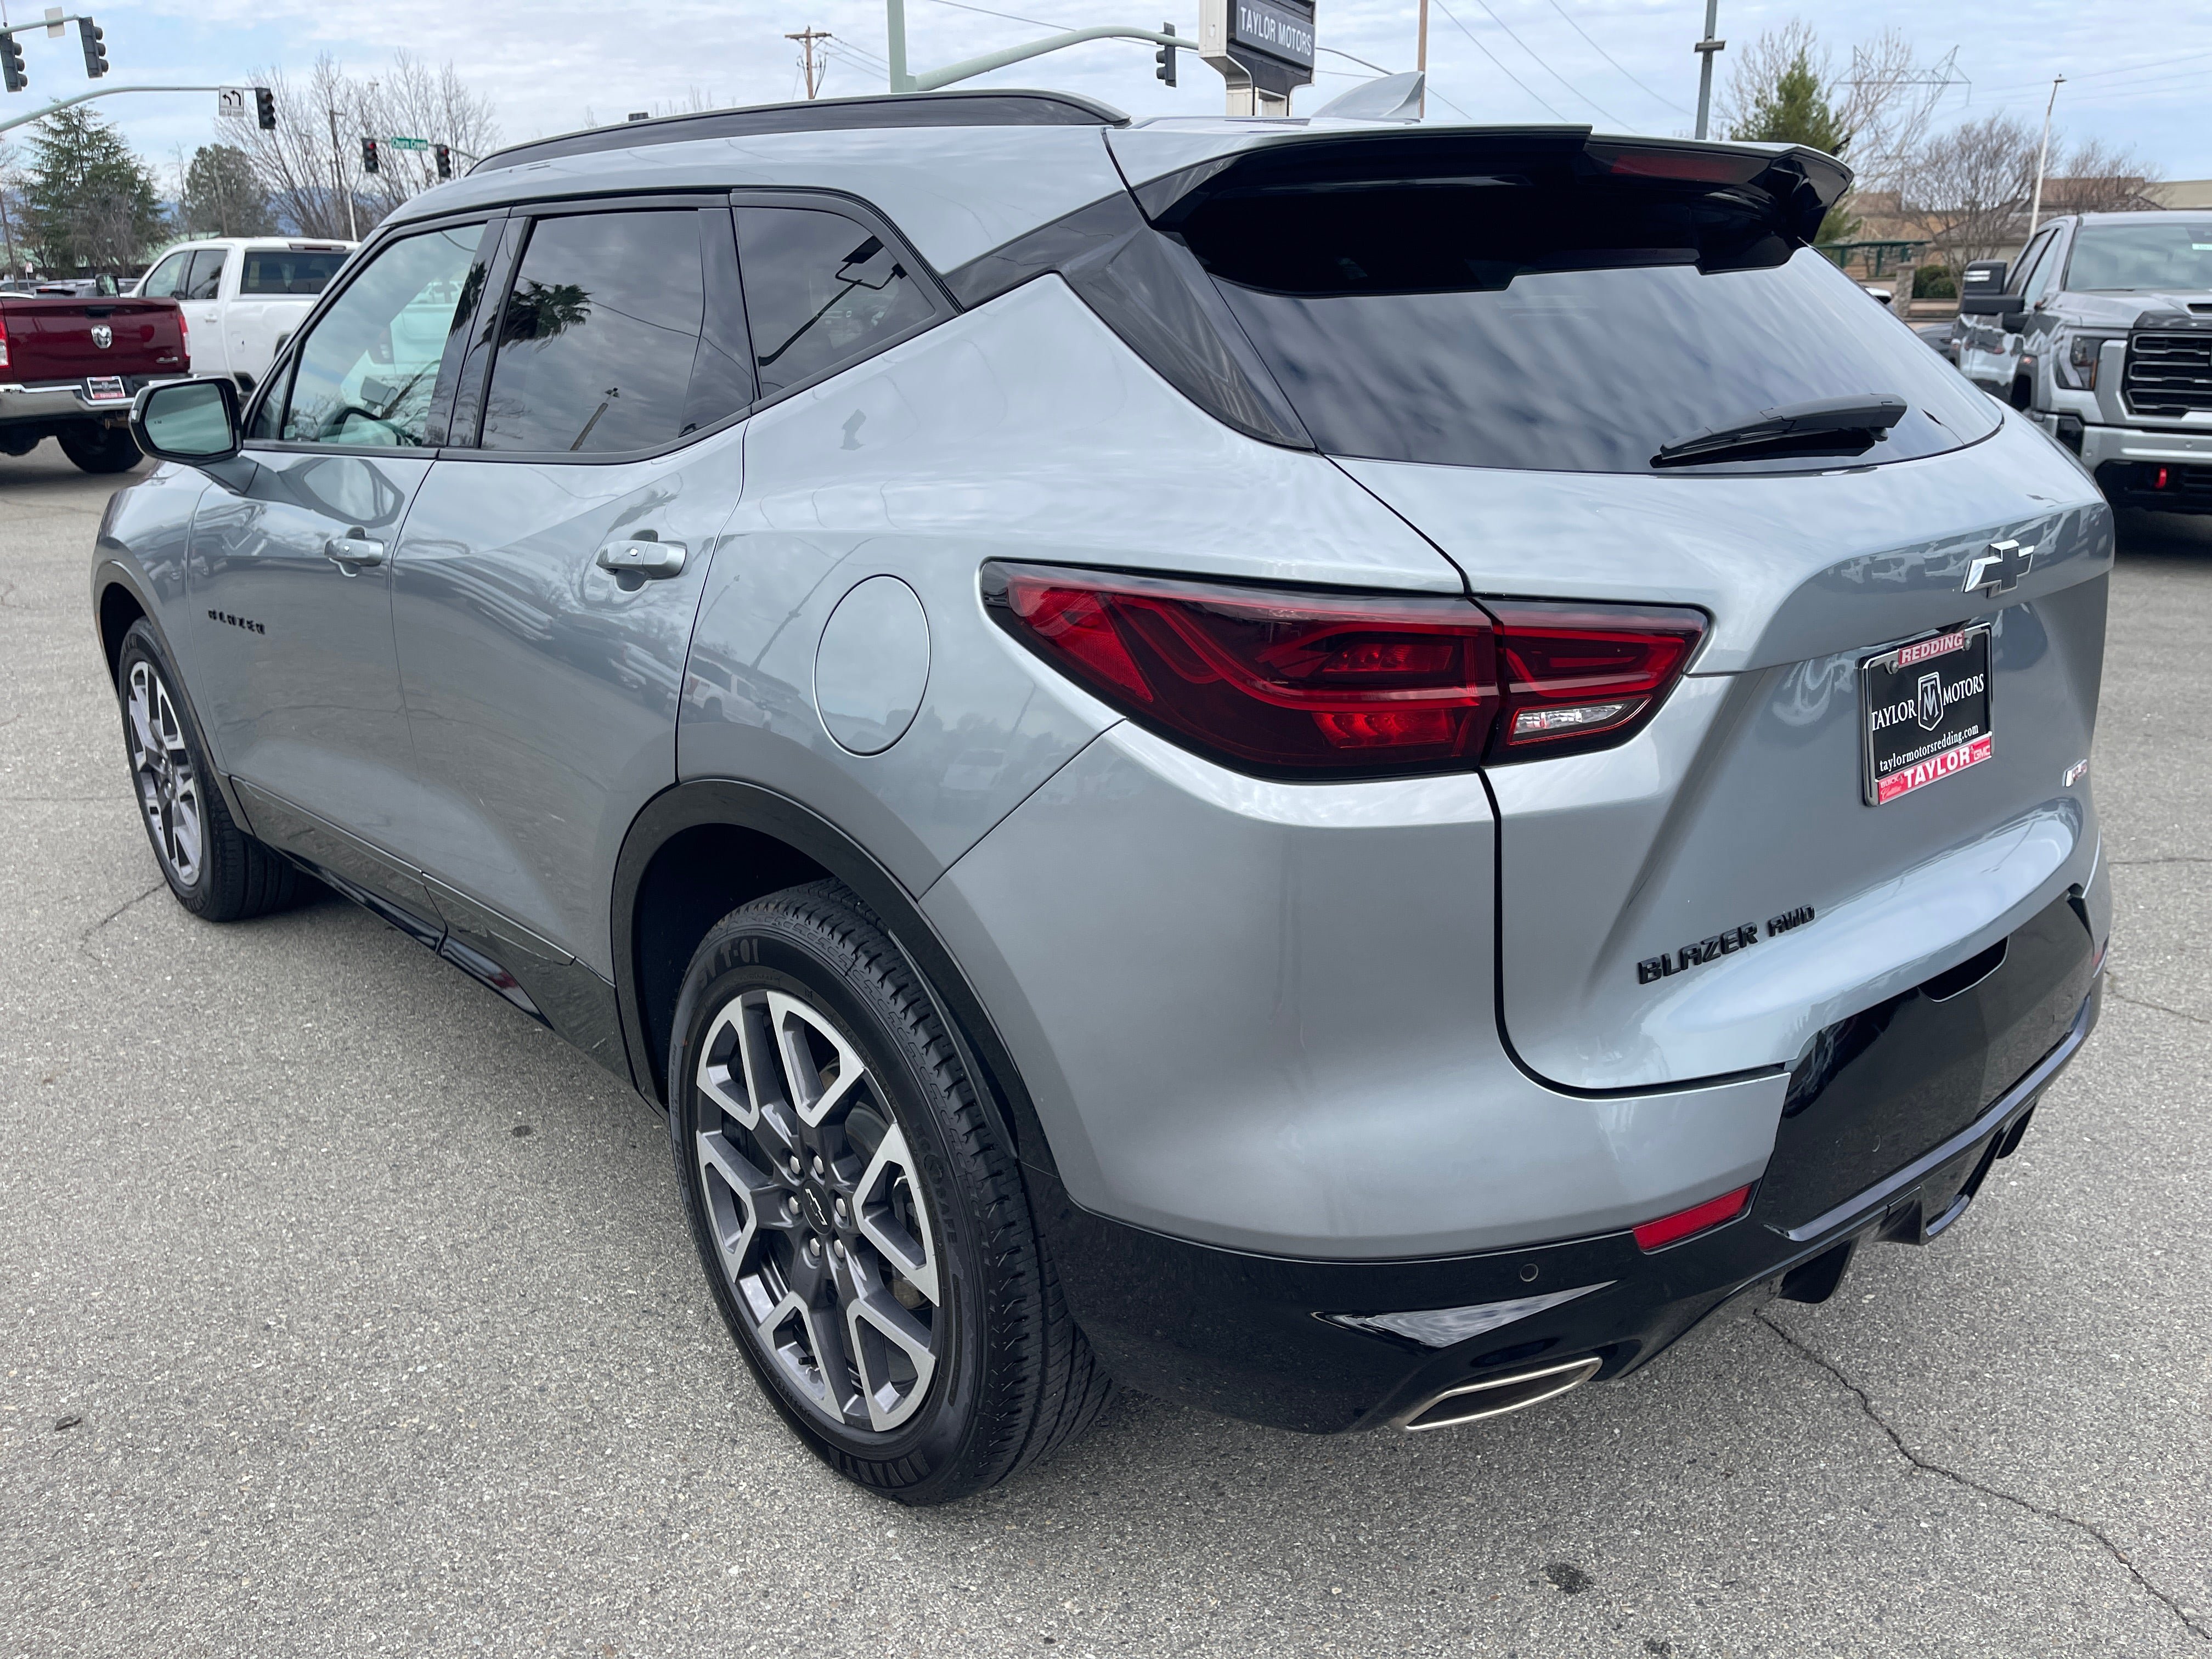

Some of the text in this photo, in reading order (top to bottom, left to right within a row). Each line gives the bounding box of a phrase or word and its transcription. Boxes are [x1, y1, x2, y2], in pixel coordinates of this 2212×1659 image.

[1240, 7, 1312, 56] TAYLOR MOTORS
[208, 609, 264, 634] BLAZER
[1901, 633, 1963, 664] REDDING
[1871, 699, 1917, 731] TAYLOR
[1943, 673, 1984, 706] MOTORS
[1880, 724, 1979, 772] taylormotorsredding.com
[1904, 747, 1970, 788] TAYLOR
[1973, 744, 1991, 761] GMC
[1638, 904, 1815, 985] BLAZER AWD
